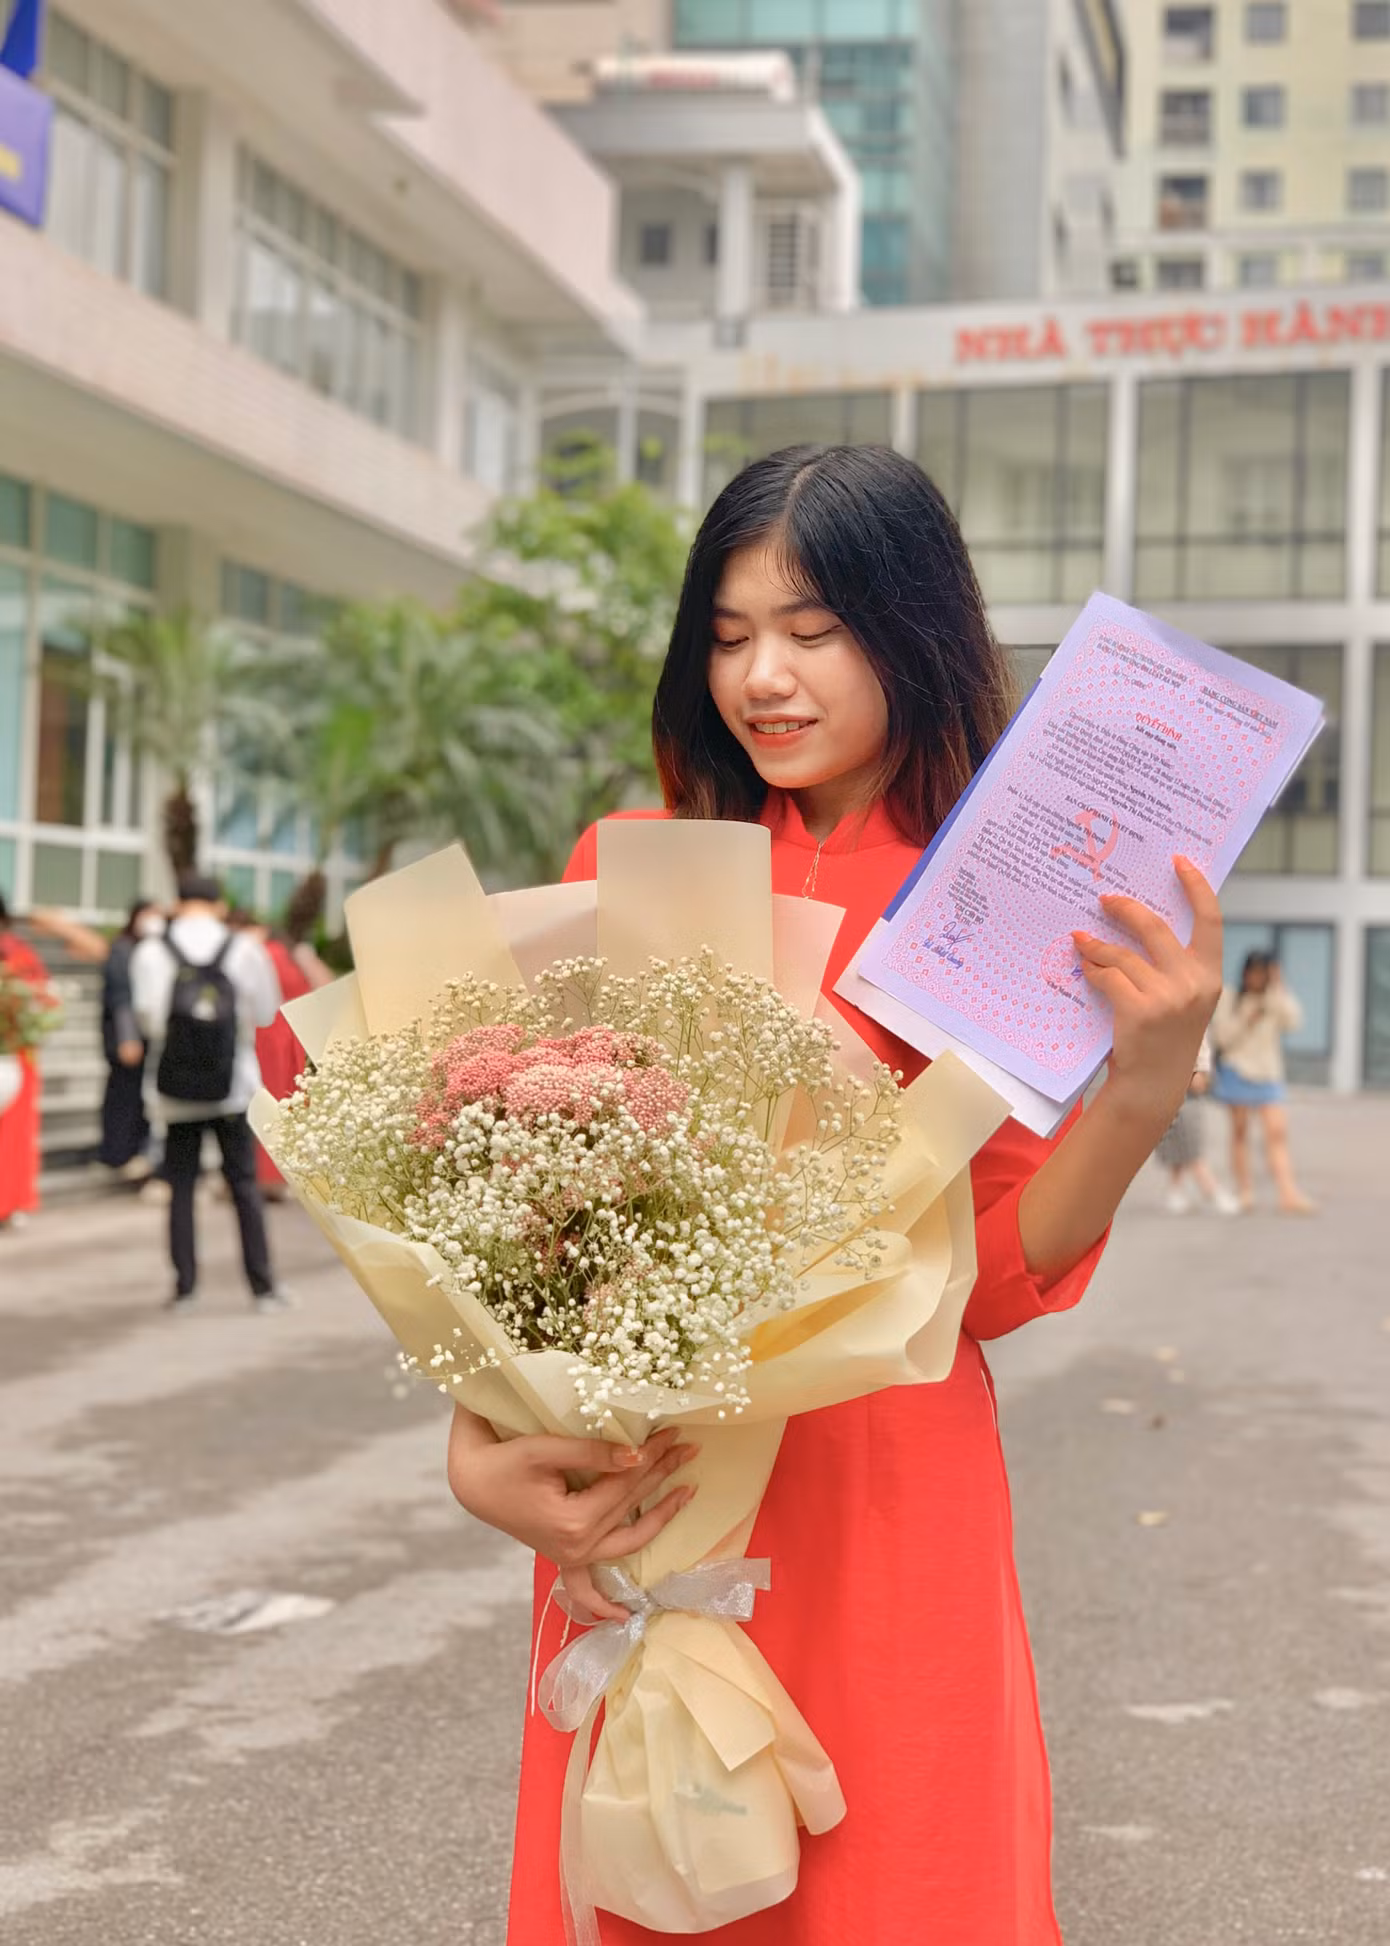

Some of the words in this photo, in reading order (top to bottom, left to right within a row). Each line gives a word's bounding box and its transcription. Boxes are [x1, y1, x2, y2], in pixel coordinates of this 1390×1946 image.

[955, 314, 1068, 361] NHÀ
[1133, 710, 1165, 732] QUYẾT
[1160, 724, 1184, 742] ĐỊNH
[1064, 794, 1078, 805] BAN
